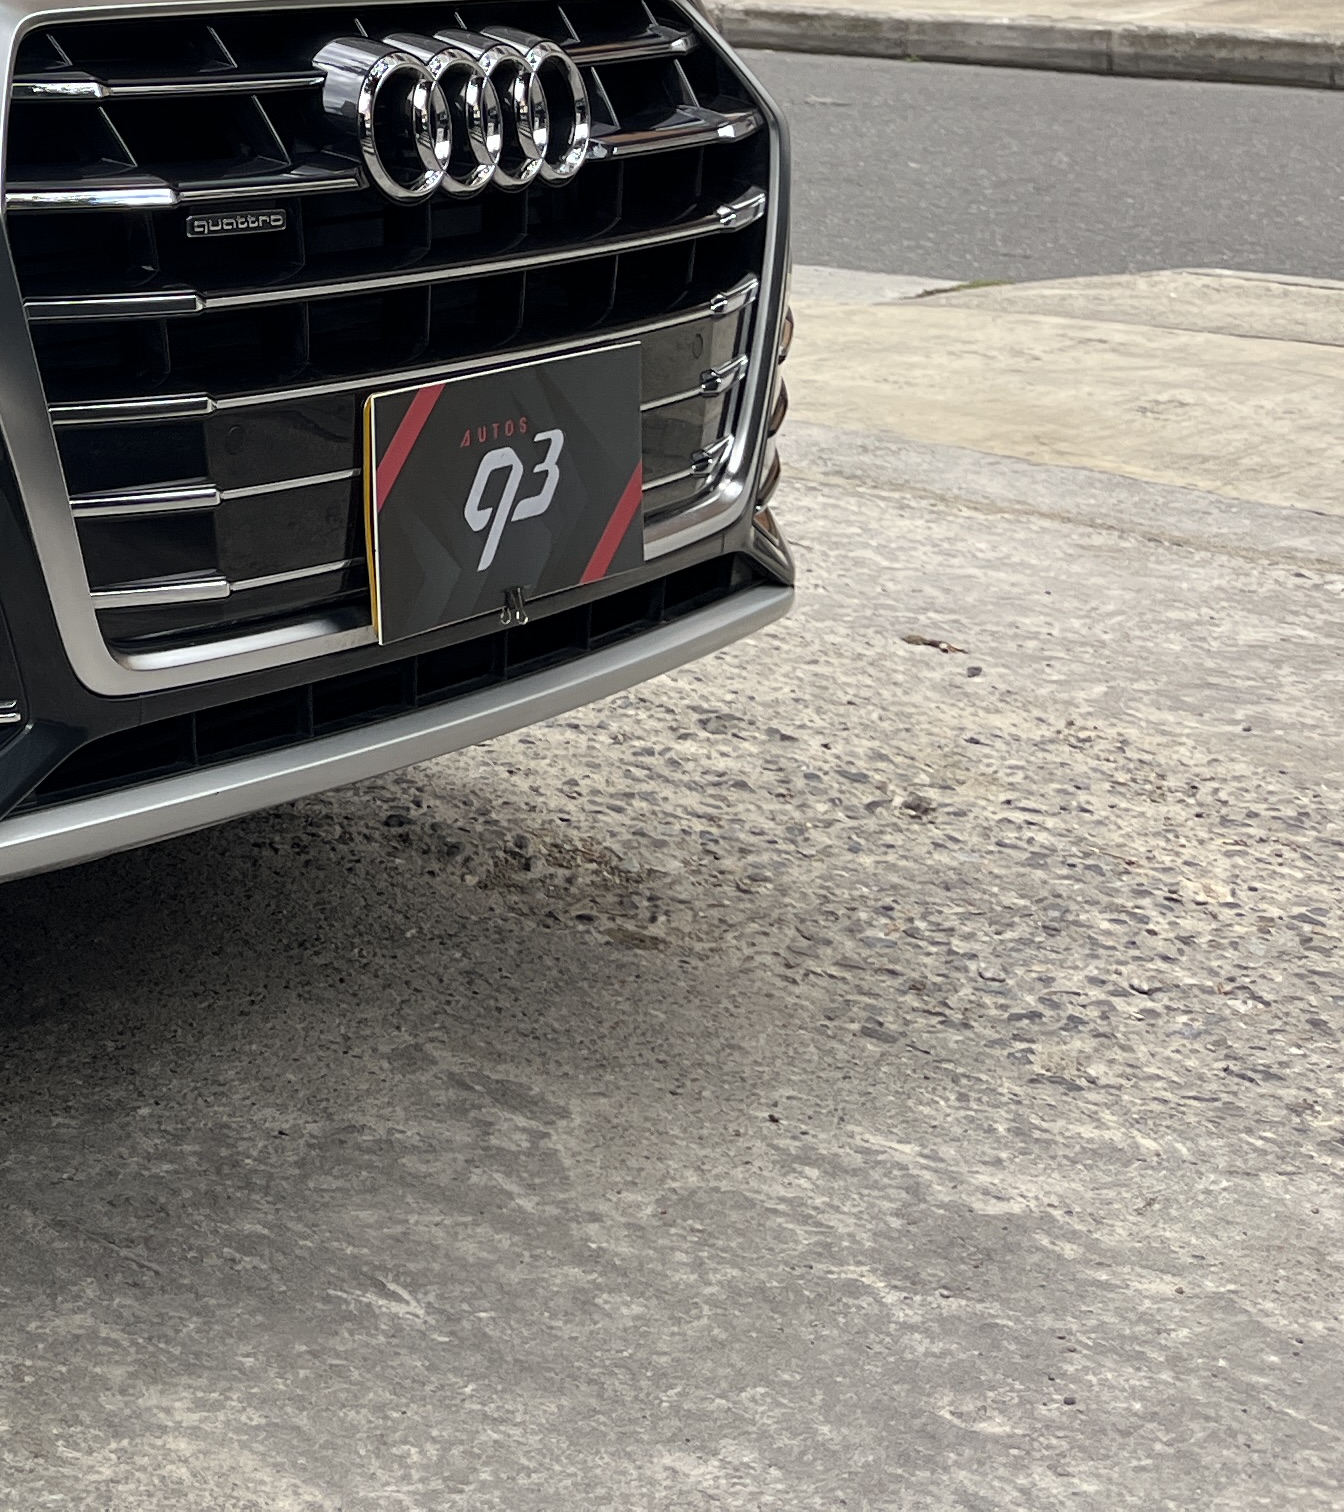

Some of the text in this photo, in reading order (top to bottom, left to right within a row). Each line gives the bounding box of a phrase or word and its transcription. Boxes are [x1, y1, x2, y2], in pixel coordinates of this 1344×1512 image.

[193, 214, 284, 235] quattro
[459, 416, 529, 448] AUTOS
[464, 428, 565, 572] 93
